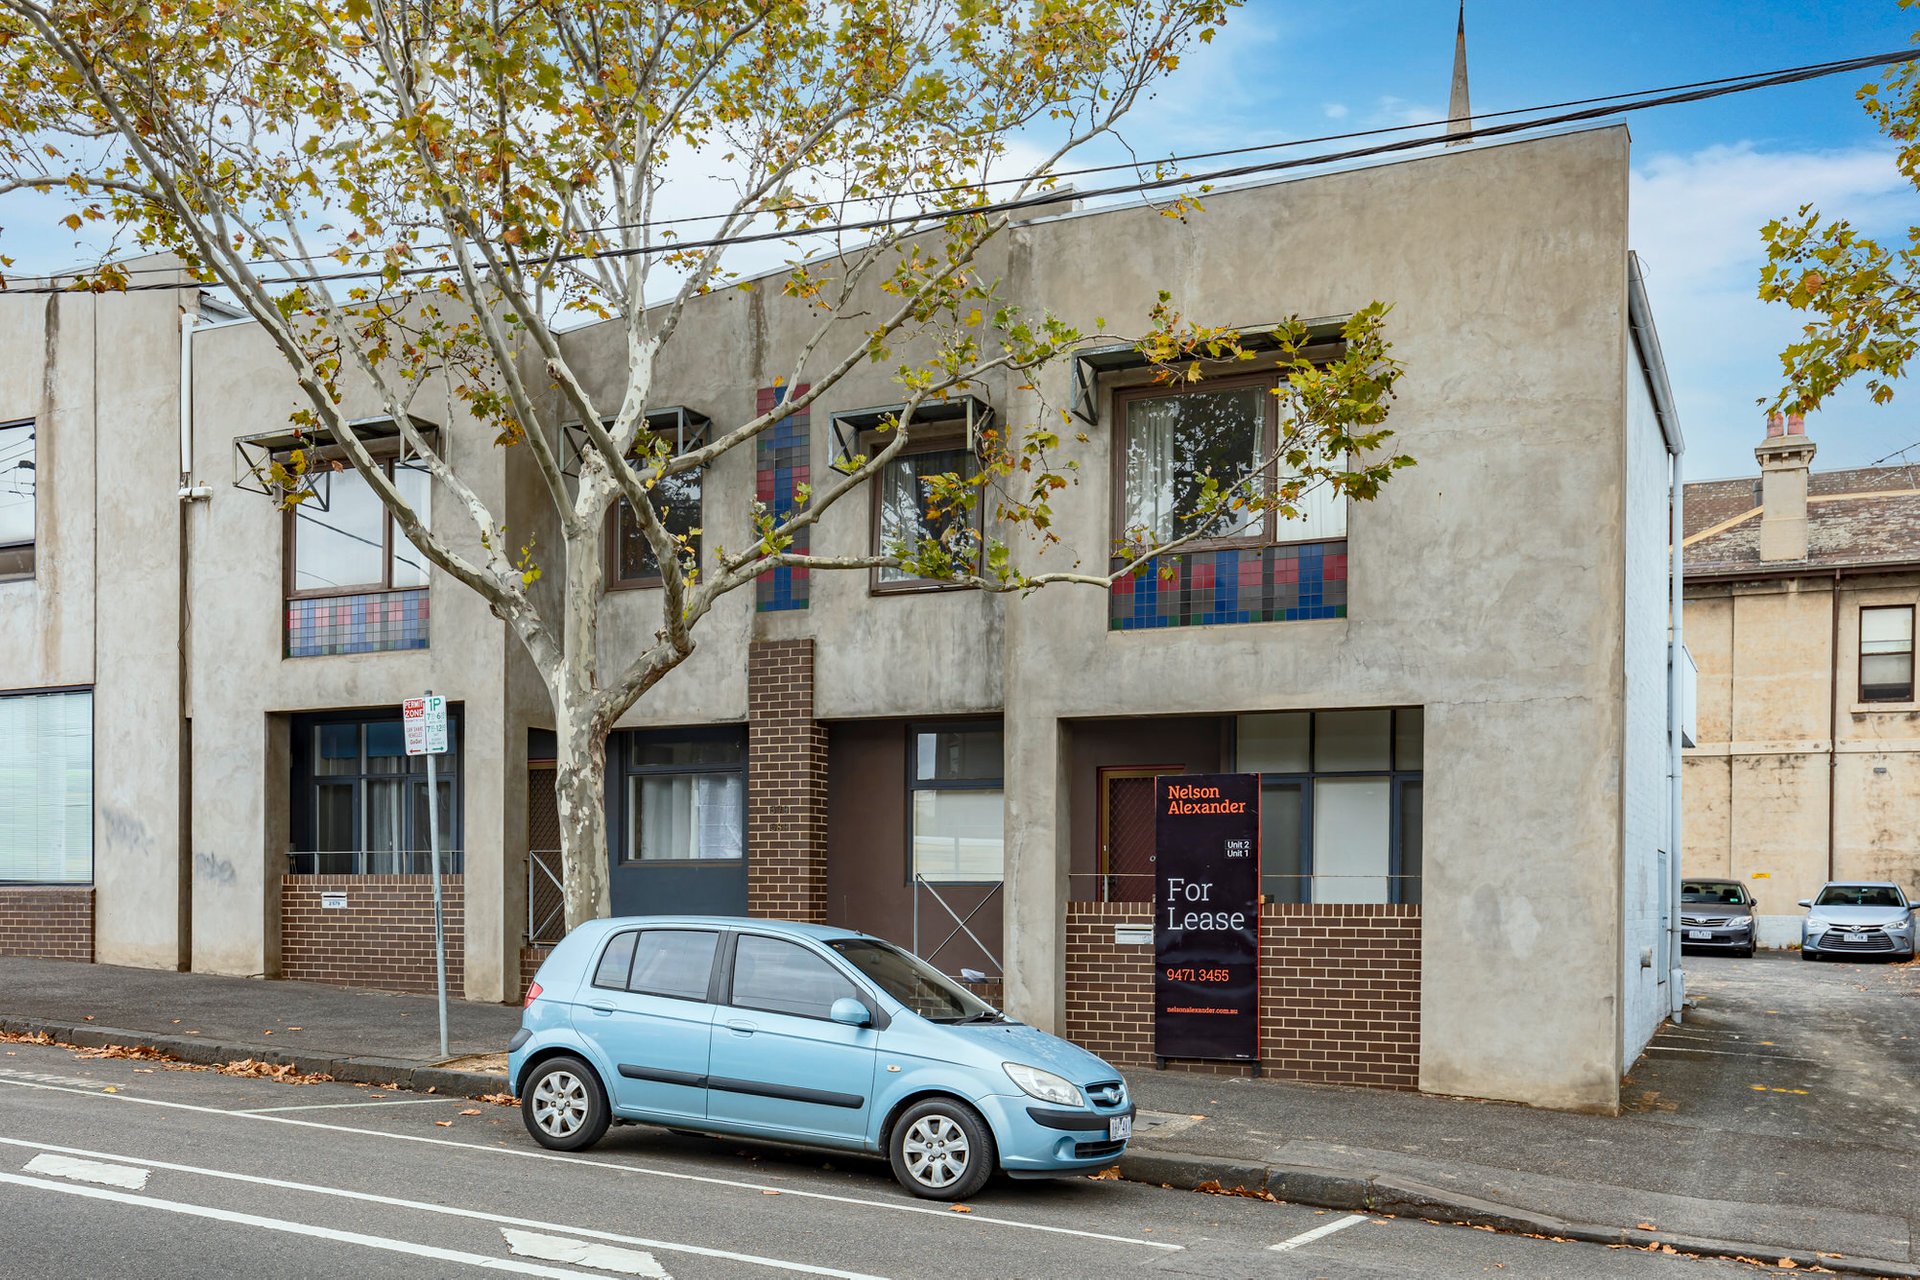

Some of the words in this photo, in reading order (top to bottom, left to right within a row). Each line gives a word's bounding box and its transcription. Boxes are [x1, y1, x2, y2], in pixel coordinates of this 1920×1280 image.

[405, 700, 424, 709] PERMIT
[429, 698, 441, 711] 1P
[405, 709, 424, 718] ZONE
[1168, 784, 1220, 800] Nelson
[1168, 799, 1246, 815] Alexander
[1227, 841, 1243, 849] Unit
[1167, 878, 1213, 902] For
[1167, 906, 1245, 931] Lease
[1166, 968, 1196, 982] 9471
[1198, 968, 1230, 982] 3455
[1166, 1006, 1239, 1015] nelsonalexander.com.au
